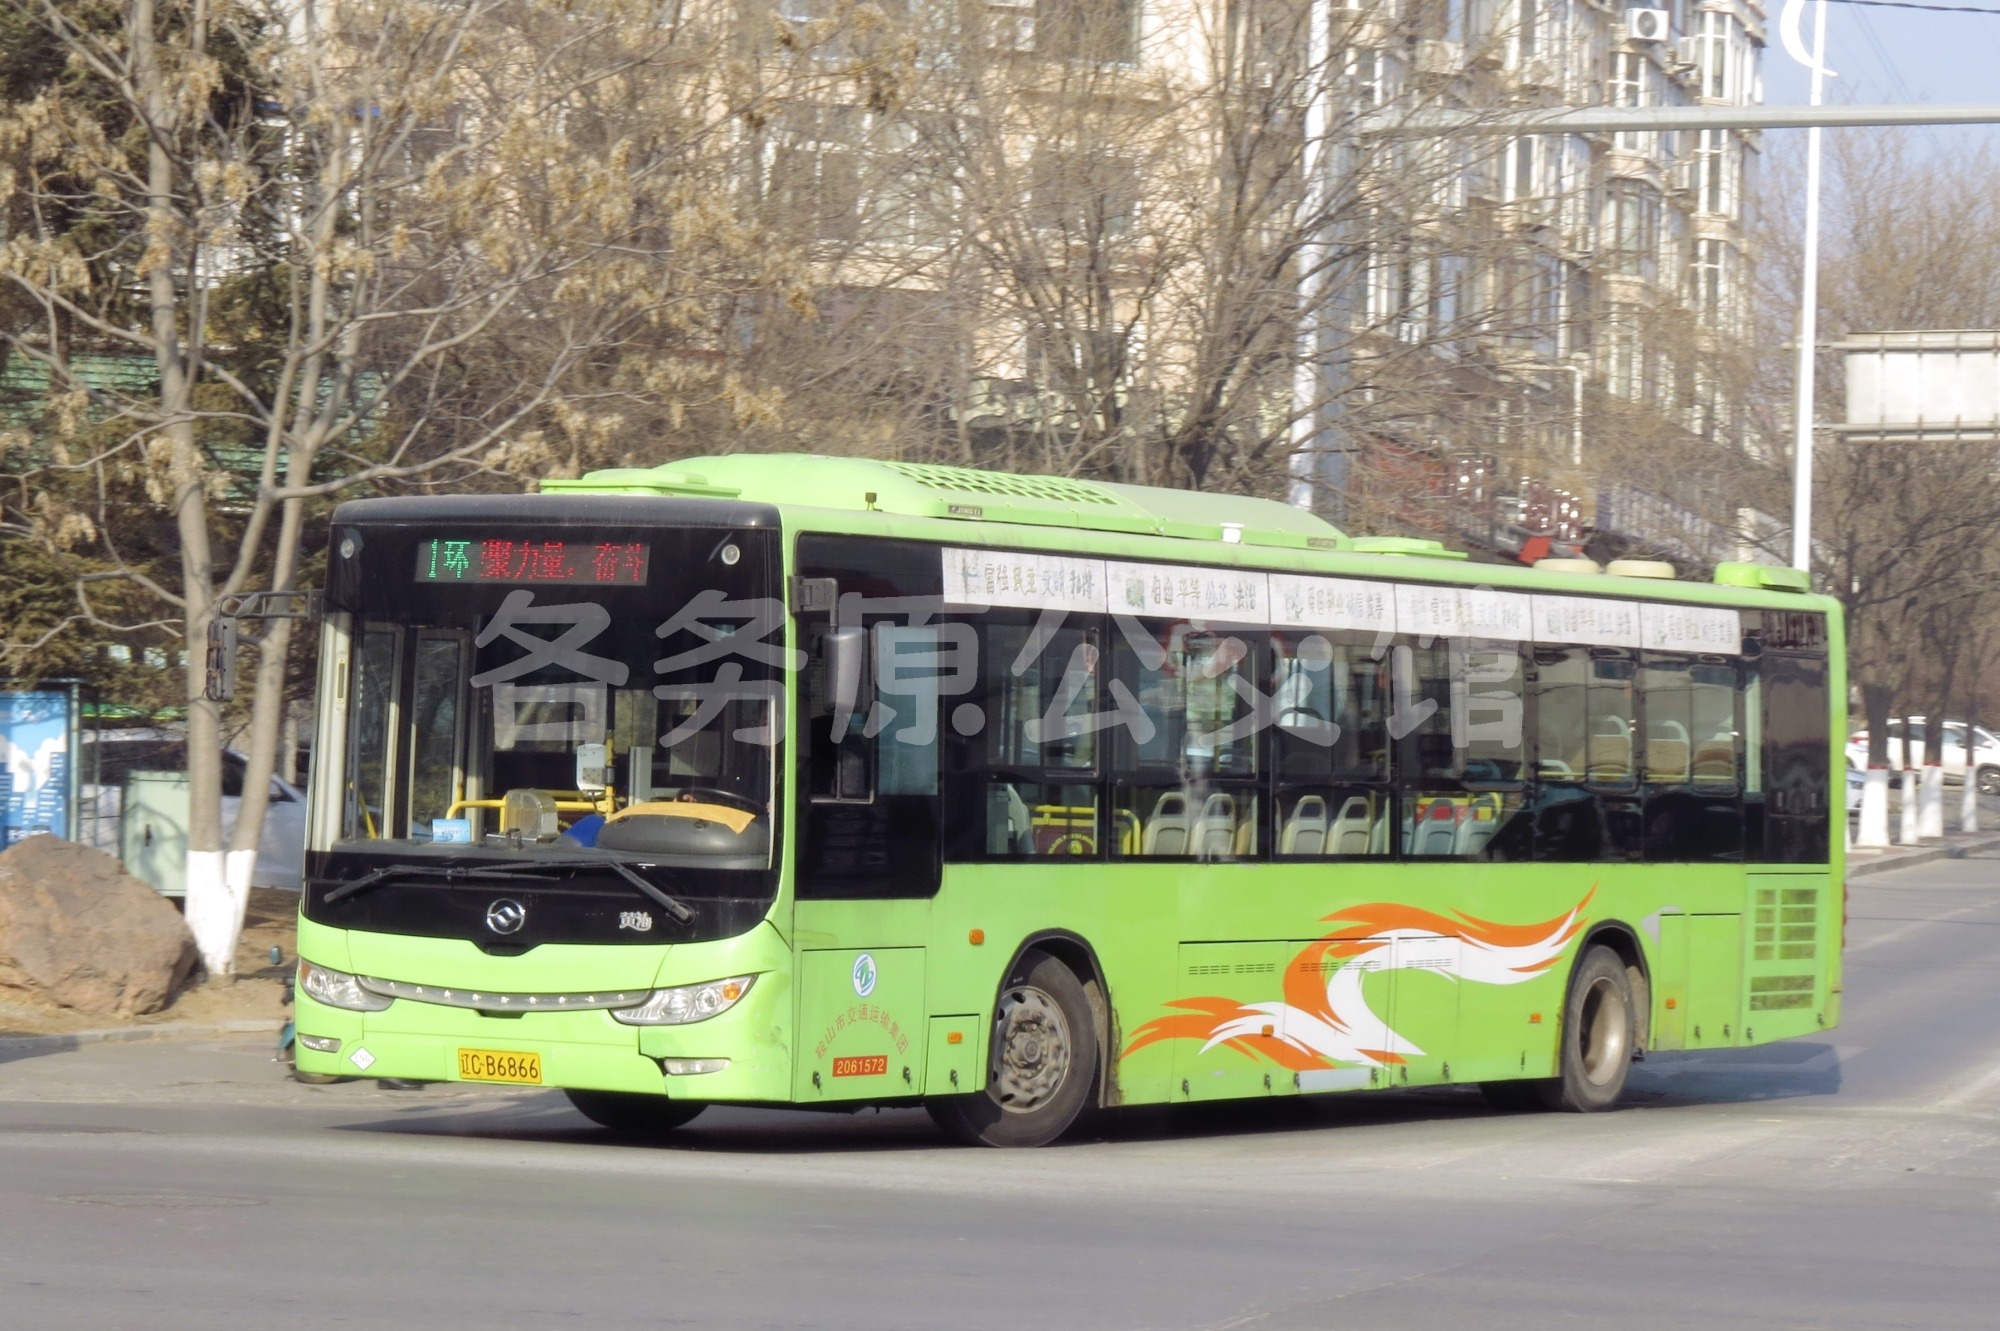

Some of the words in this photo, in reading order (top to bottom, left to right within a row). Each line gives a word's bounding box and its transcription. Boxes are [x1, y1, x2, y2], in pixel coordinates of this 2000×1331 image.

[1151, 575, 1174, 606] 自由
[1176, 577, 1202, 609] 平等
[836, 1058, 885, 1074] 2061572
